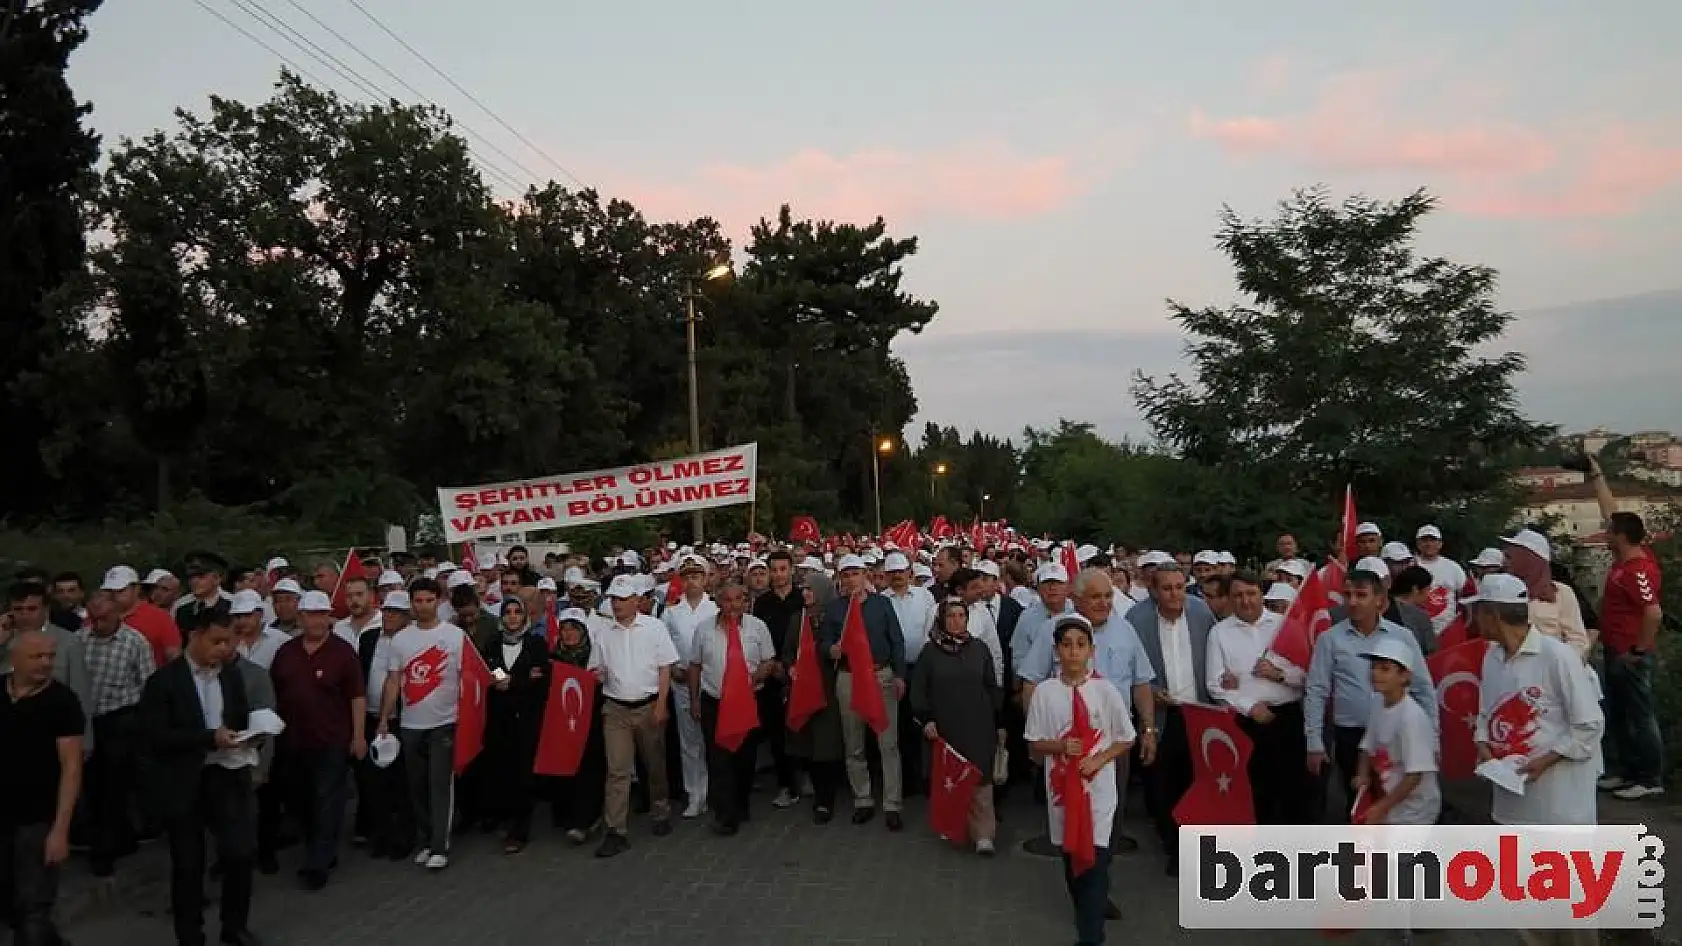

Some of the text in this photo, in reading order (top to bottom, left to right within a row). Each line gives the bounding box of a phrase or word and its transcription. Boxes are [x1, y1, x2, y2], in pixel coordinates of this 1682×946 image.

[450, 477, 750, 533] VATAN BÖLÜNMEZ
[455, 454, 744, 512] ŞEHİTLER ÖLMEZ
